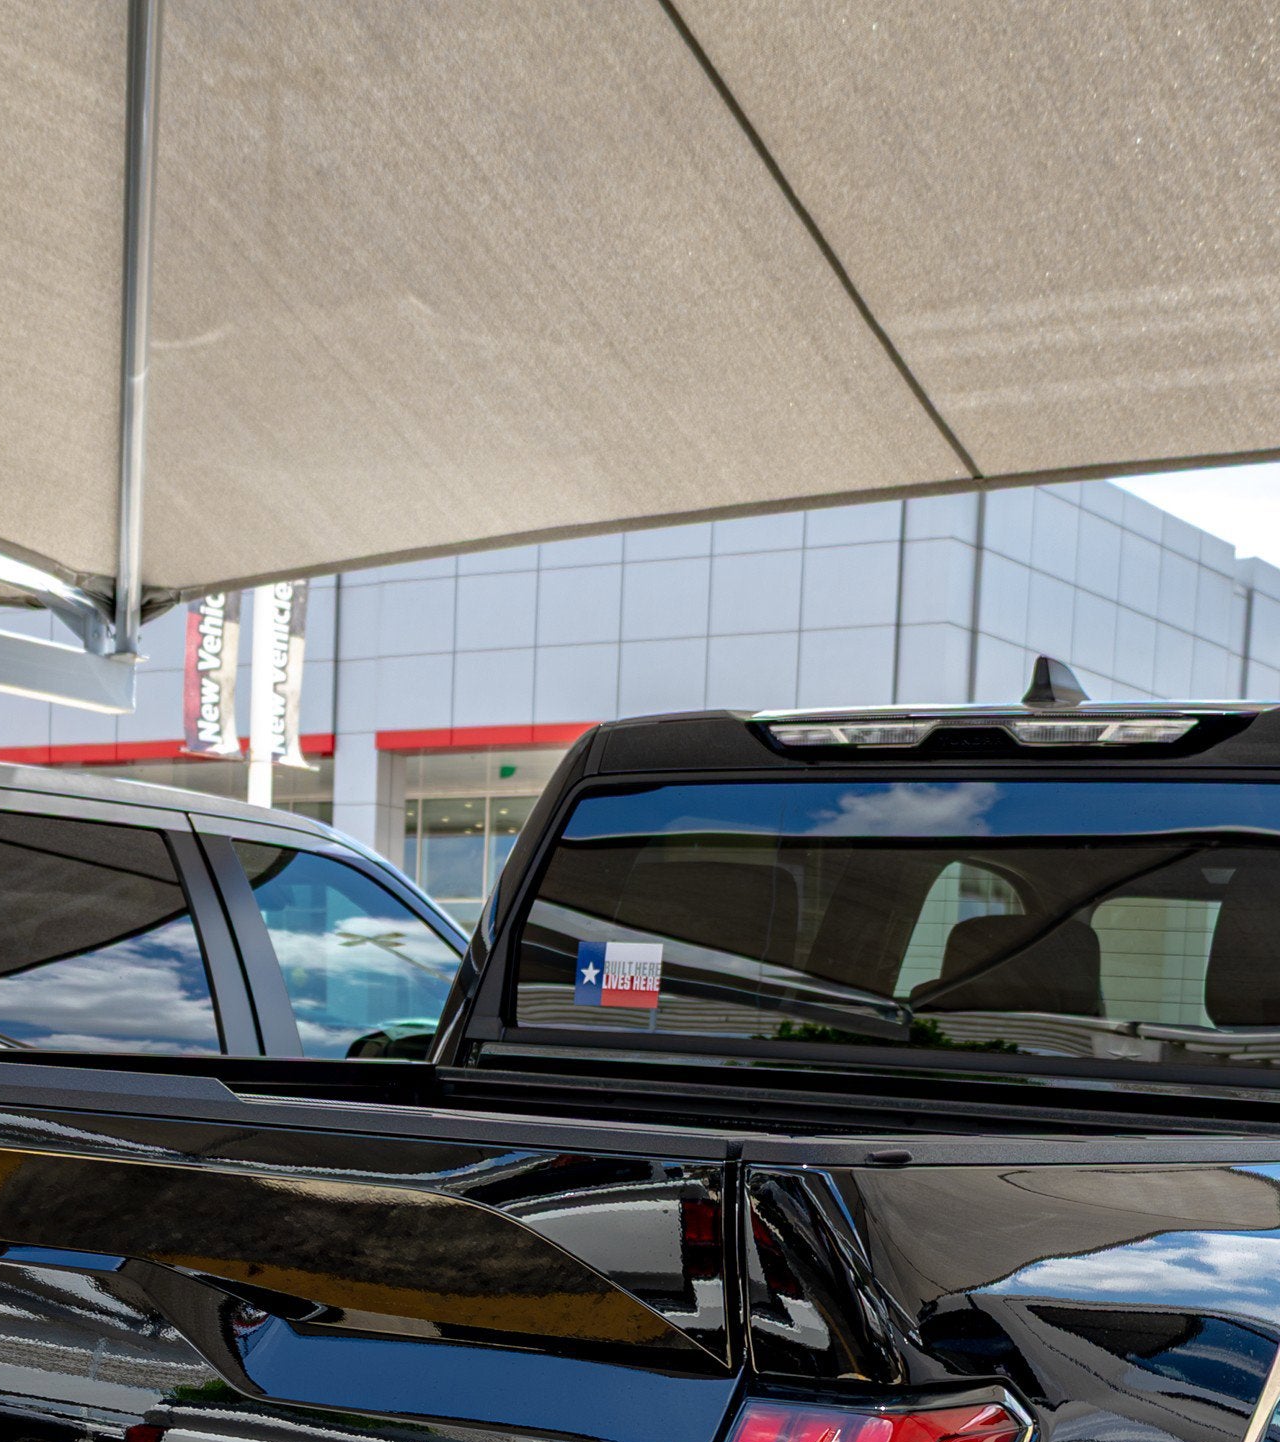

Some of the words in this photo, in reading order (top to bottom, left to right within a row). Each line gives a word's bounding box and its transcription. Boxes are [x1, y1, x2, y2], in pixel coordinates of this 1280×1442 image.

[197, 591, 226, 671] Vehic
[271, 581, 294, 685] Vehicle
[197, 677, 223, 744] New
[602, 973, 631, 990] LIVES
[633, 976, 660, 991] HERE
[604, 960, 633, 975] BUILT
[635, 962, 661, 976] HERE
